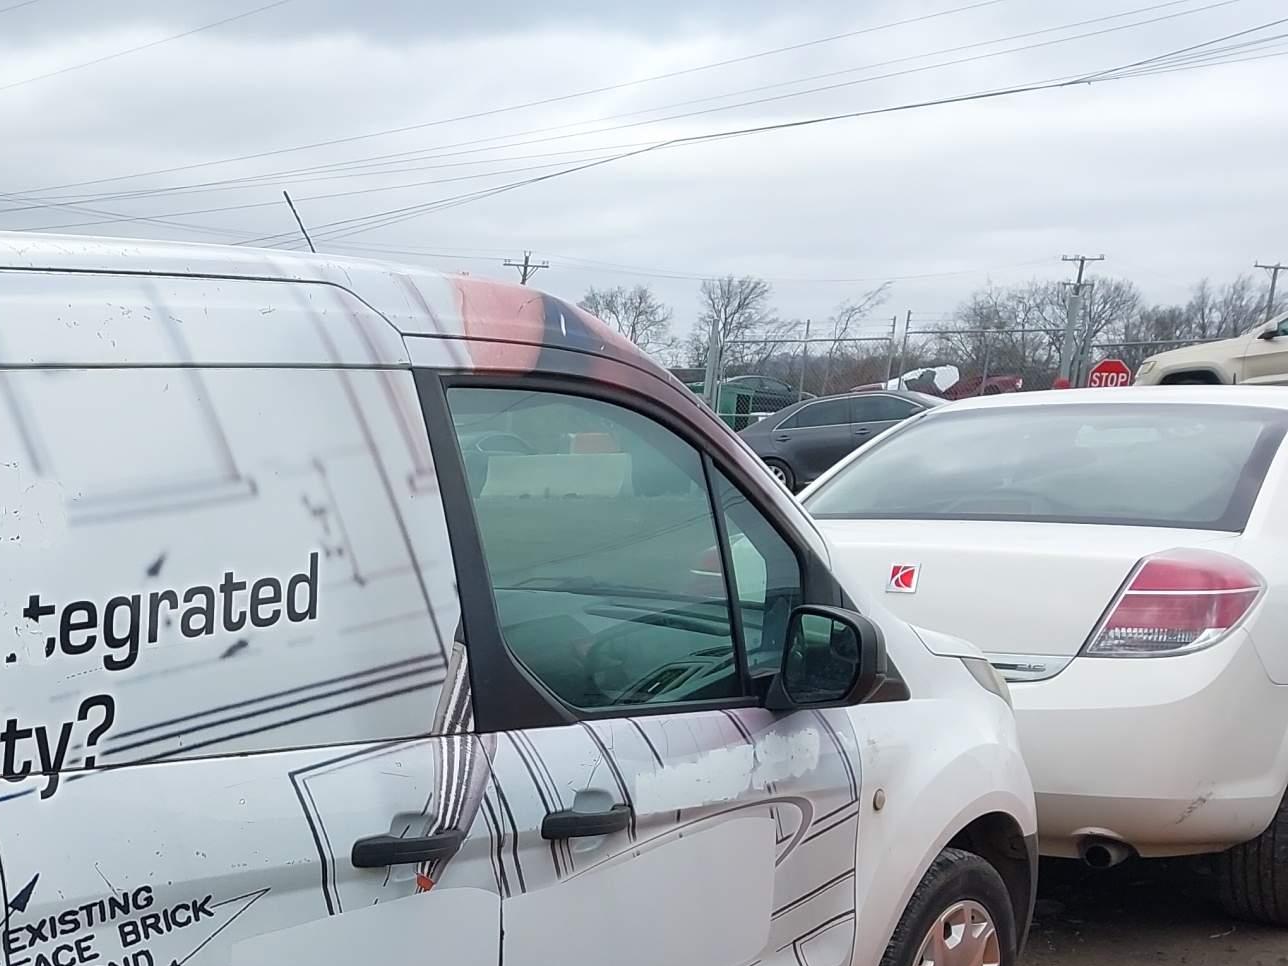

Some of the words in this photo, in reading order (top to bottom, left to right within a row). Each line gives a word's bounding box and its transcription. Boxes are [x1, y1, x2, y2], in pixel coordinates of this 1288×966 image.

[1091, 372, 1128, 387] STOP
[3, 885, 154, 954] EXISTING
[118, 894, 214, 947] BRICK
